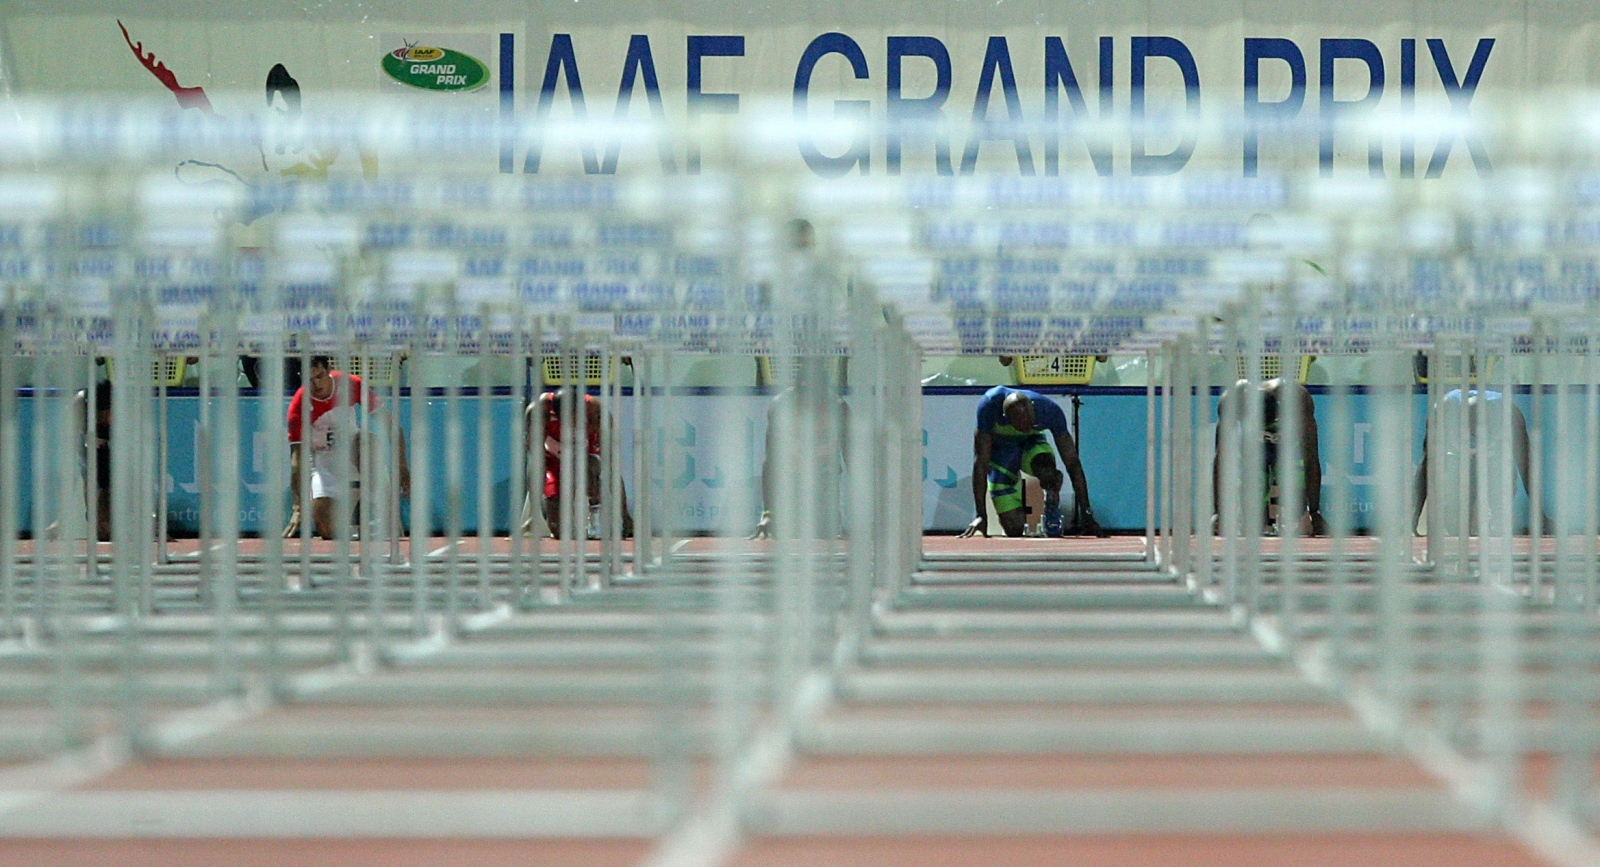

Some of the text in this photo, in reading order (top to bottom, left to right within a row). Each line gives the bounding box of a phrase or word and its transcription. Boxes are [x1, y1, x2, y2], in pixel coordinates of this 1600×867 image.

[410, 64, 456, 75] GRAND
[436, 75, 467, 85] PRIX
[500, 32, 1497, 180] IAAF GRAND PRIX
[1051, 357, 1060, 372] 4
[327, 432, 336, 447] 5
